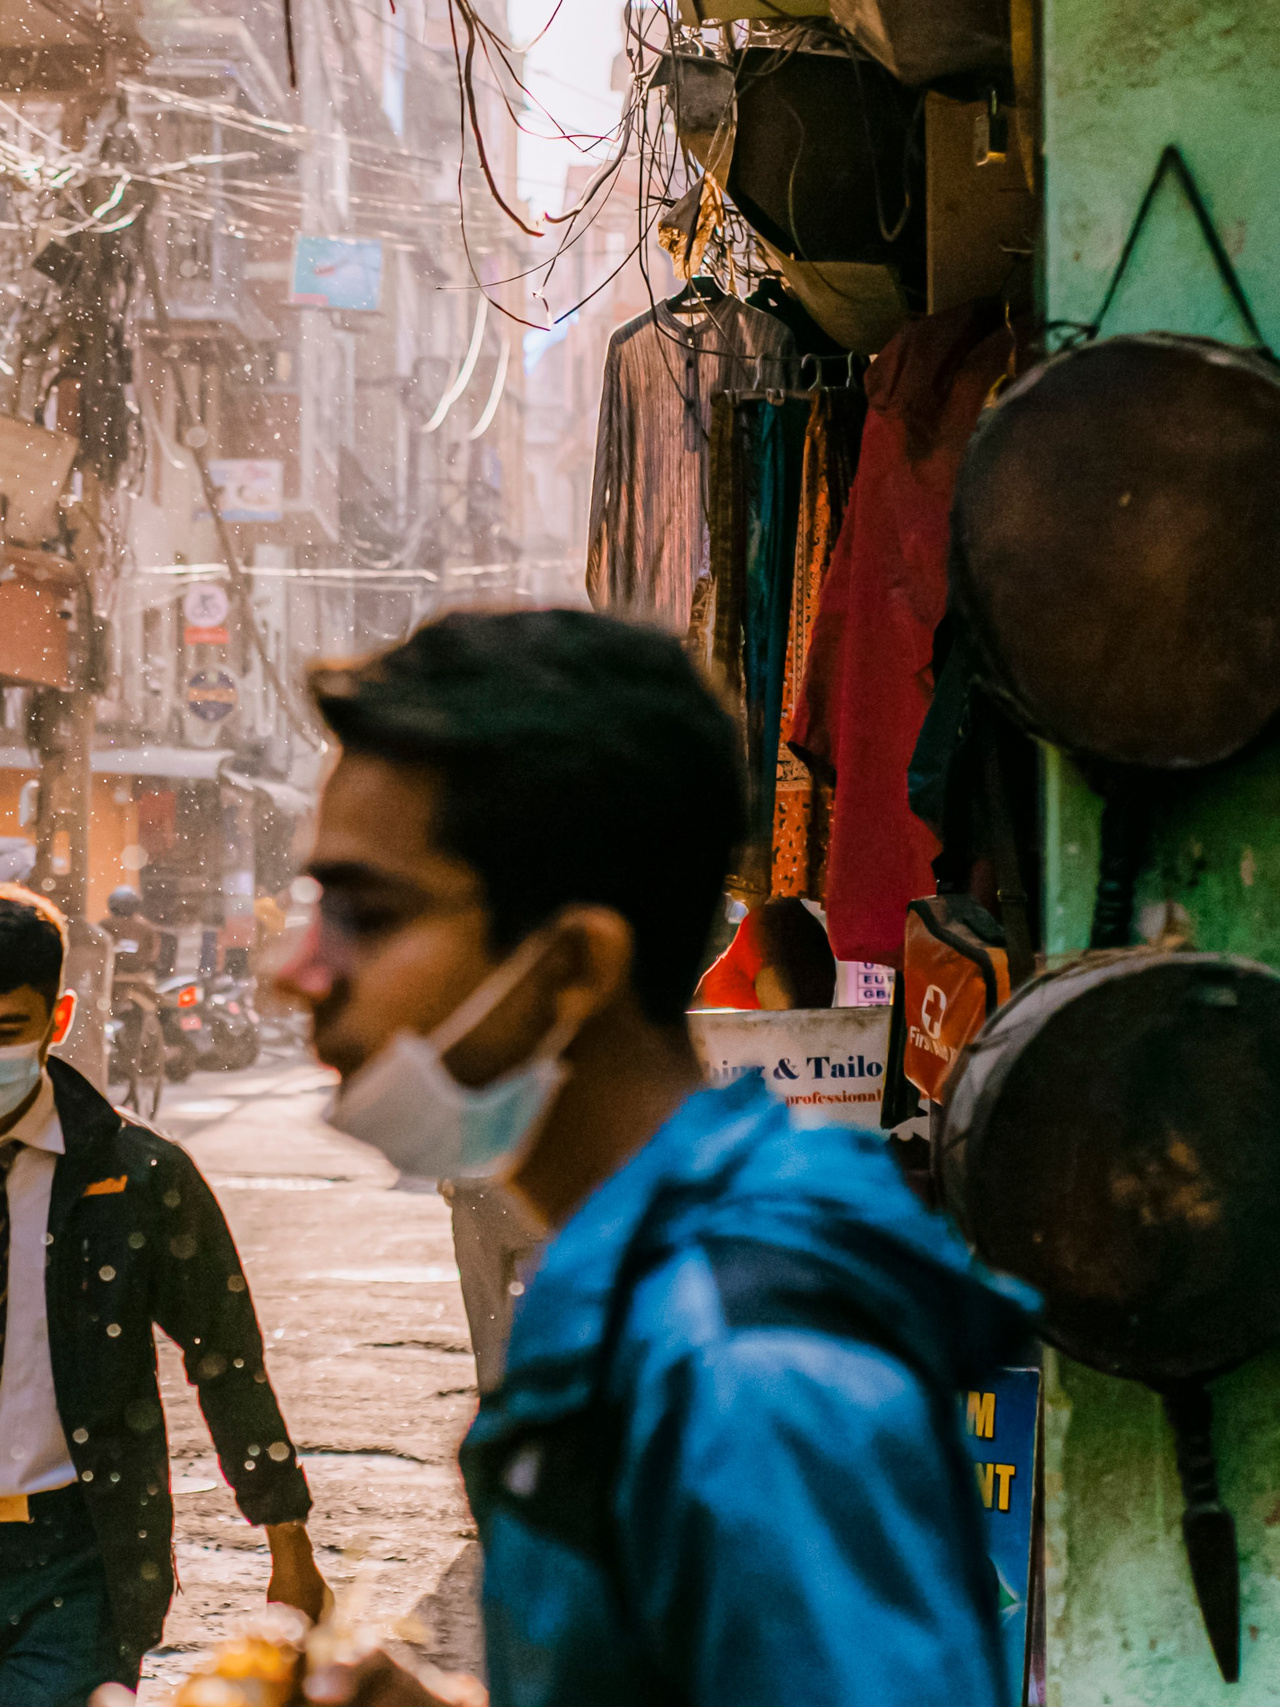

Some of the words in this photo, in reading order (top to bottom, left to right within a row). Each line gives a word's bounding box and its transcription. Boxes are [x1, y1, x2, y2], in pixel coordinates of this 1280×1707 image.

[863, 989, 891, 999] GB
[773, 1057, 800, 1081] &
[806, 1054, 883, 1080] Tailo
[785, 1088, 882, 1108] professional
